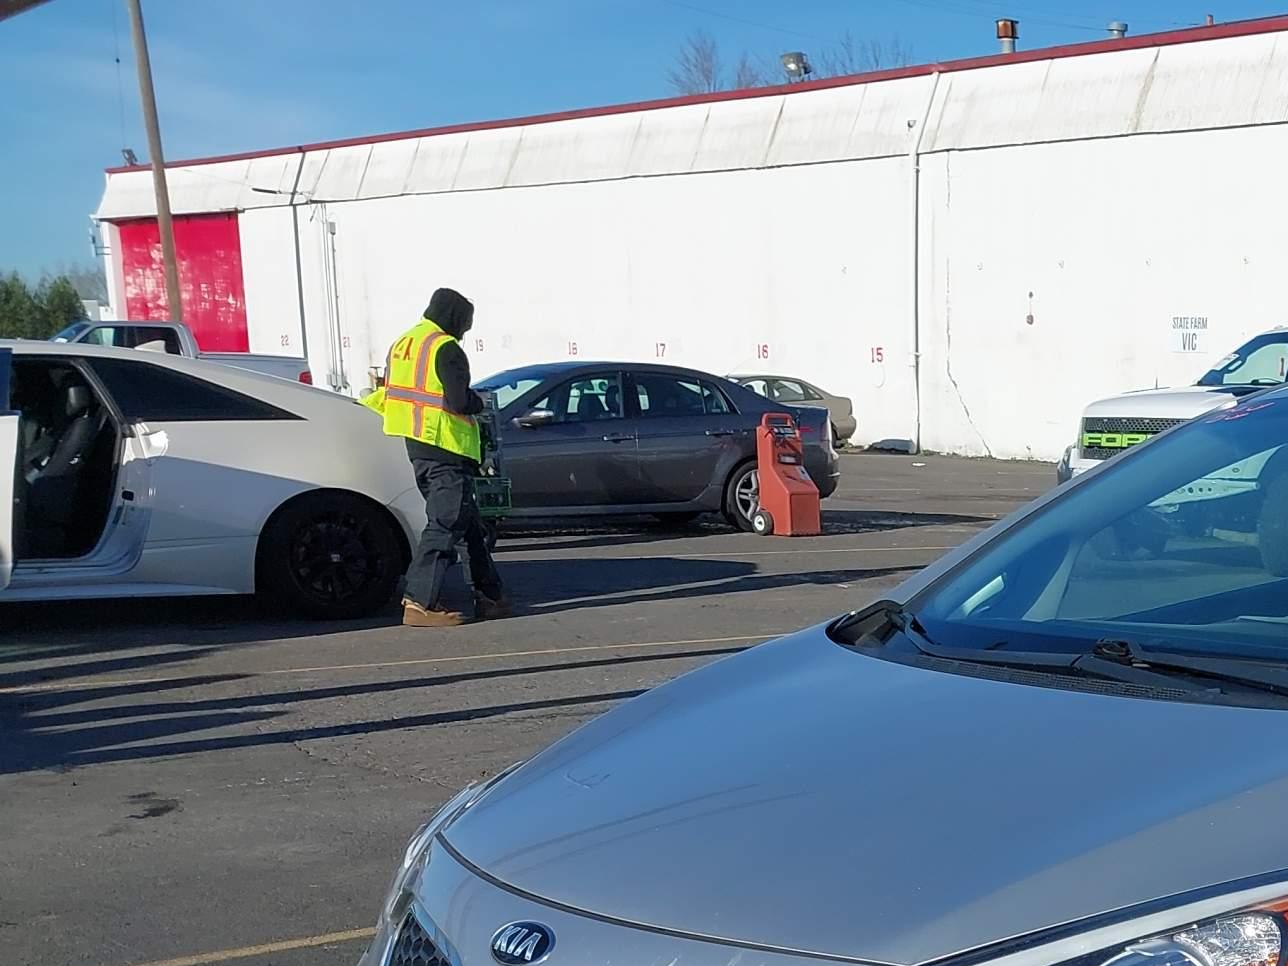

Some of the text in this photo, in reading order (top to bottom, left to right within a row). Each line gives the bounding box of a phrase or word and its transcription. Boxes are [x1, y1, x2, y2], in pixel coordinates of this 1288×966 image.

[1172, 316, 1208, 330] STATE FARM
[656, 342, 666, 357] 17
[1181, 332, 1198, 351] VIC
[757, 343, 769, 359] 16
[871, 347, 884, 363] 15
[1084, 432, 1150, 447] FOR
[494, 925, 543, 961] KIA
